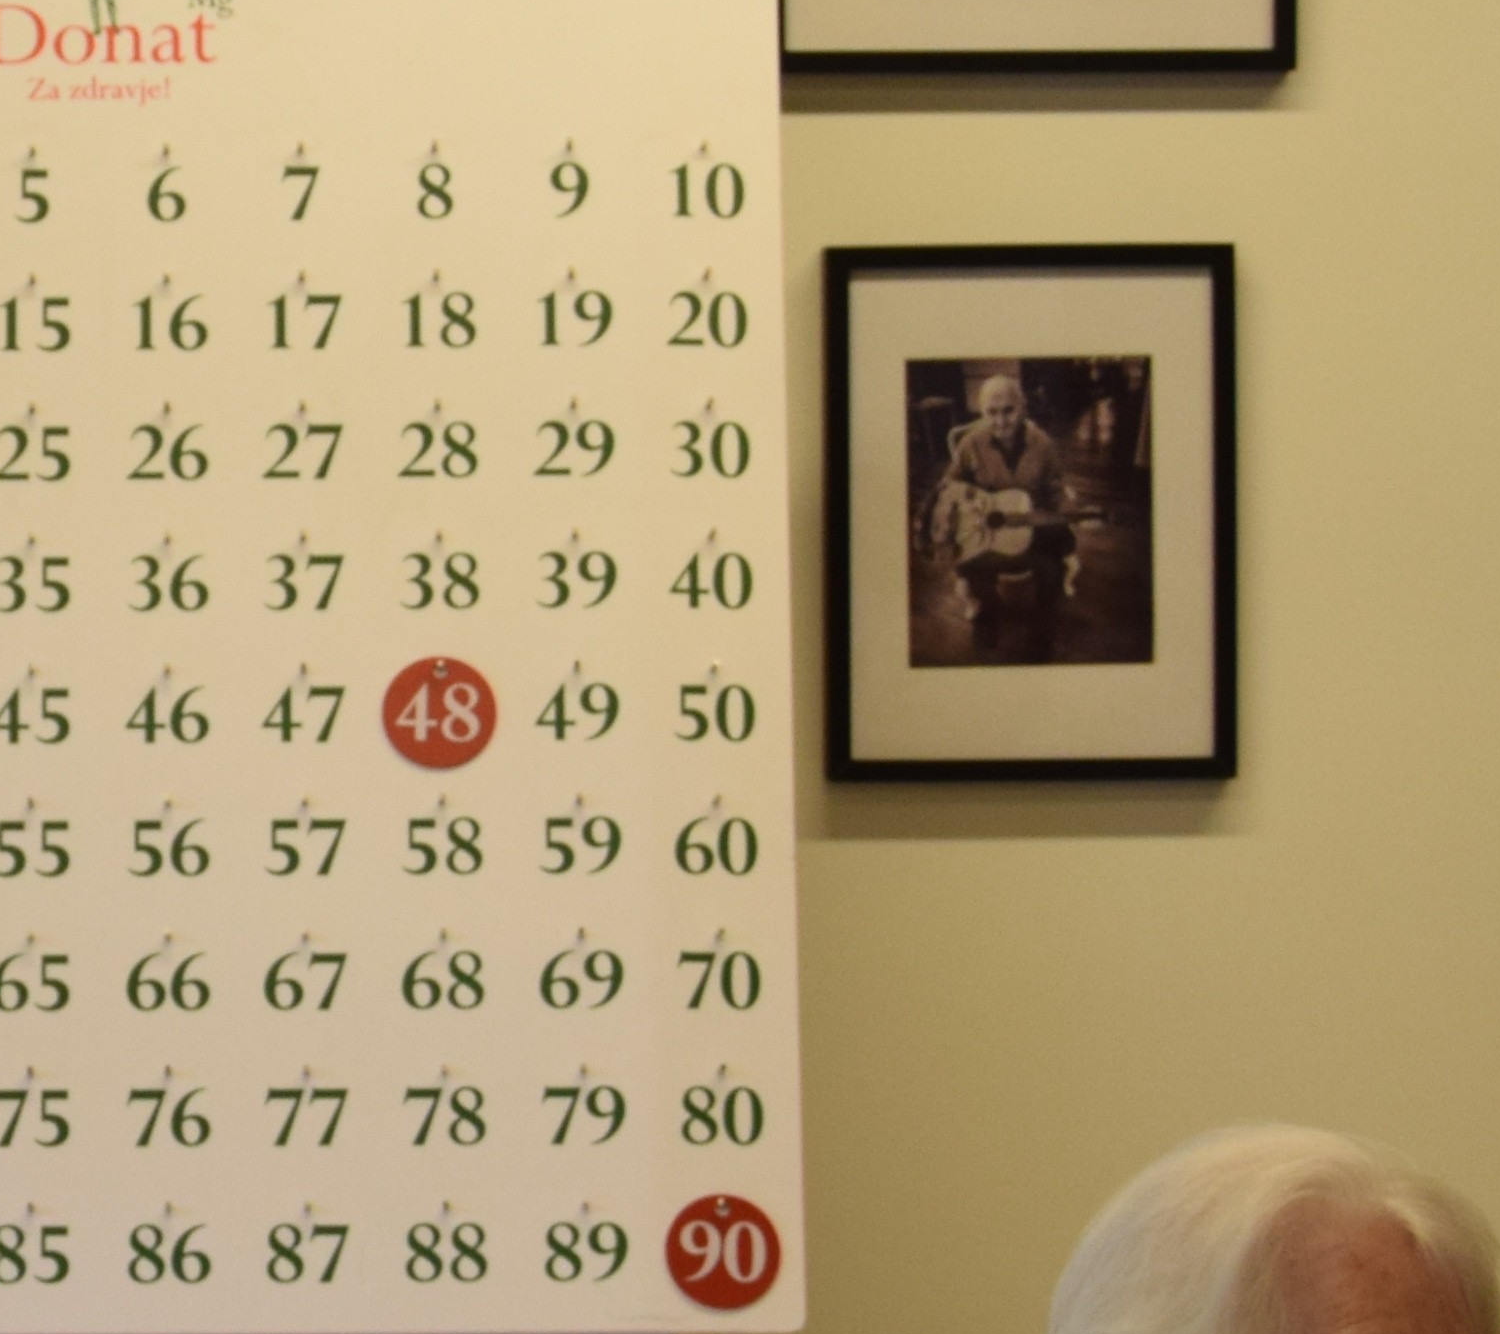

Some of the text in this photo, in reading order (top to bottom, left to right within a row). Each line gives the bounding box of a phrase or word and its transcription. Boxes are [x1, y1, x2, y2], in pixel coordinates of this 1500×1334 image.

[27, 75, 172, 106] Za zdravje!
[18, 168, 51, 224] 5
[146, 167, 187, 222] 6
[282, 165, 320, 221] 7
[416, 163, 454, 219] 8
[549, 160, 590, 217] 9
[673, 164, 746, 218] 10
[0, 297, 72, 352] 15
[135, 296, 209, 351] 16
[270, 294, 343, 350] 17
[405, 292, 478, 348] 18
[540, 291, 614, 346] 19
[667, 291, 749, 348] 20
[126, 424, 210, 481] 26
[262, 423, 344, 480] 27
[397, 422, 479, 478] 28
[533, 420, 616, 476] 29
[676, 421, 751, 478] 30
[132, 555, 210, 612] 36
[267, 554, 345, 611] 37
[405, 553, 481, 610] 38
[541, 551, 618, 609] 39
[669, 553, 754, 609] 40
[125, 687, 211, 744] 46
[261, 686, 346, 743] 47
[394, 682, 481, 743] 48
[535, 683, 621, 741] 49
[677, 684, 757, 742] 50
[129, 820, 211, 877] 56
[267, 818, 347, 876] 57
[404, 817, 484, 875] 58
[542, 816, 623, 875] 59
[673, 818, 759, 876] 60
[125, 953, 212, 1011] 66
[262, 952, 348, 1011] 67
[400, 951, 486, 1010] 68
[538, 950, 625, 1009] 69
[678, 951, 762, 1010] 70
[127, 1088, 212, 1147] 76
[265, 1088, 349, 1147] 77
[403, 1086, 487, 1146] 78
[542, 1086, 627, 1145] 79
[680, 1086, 765, 1146] 80
[127, 1223, 213, 1284] 86
[265, 1224, 350, 1283] 87
[404, 1223, 489, 1282] 88
[543, 1222, 630, 1282] 89
[679, 1221, 767, 1282] 90
